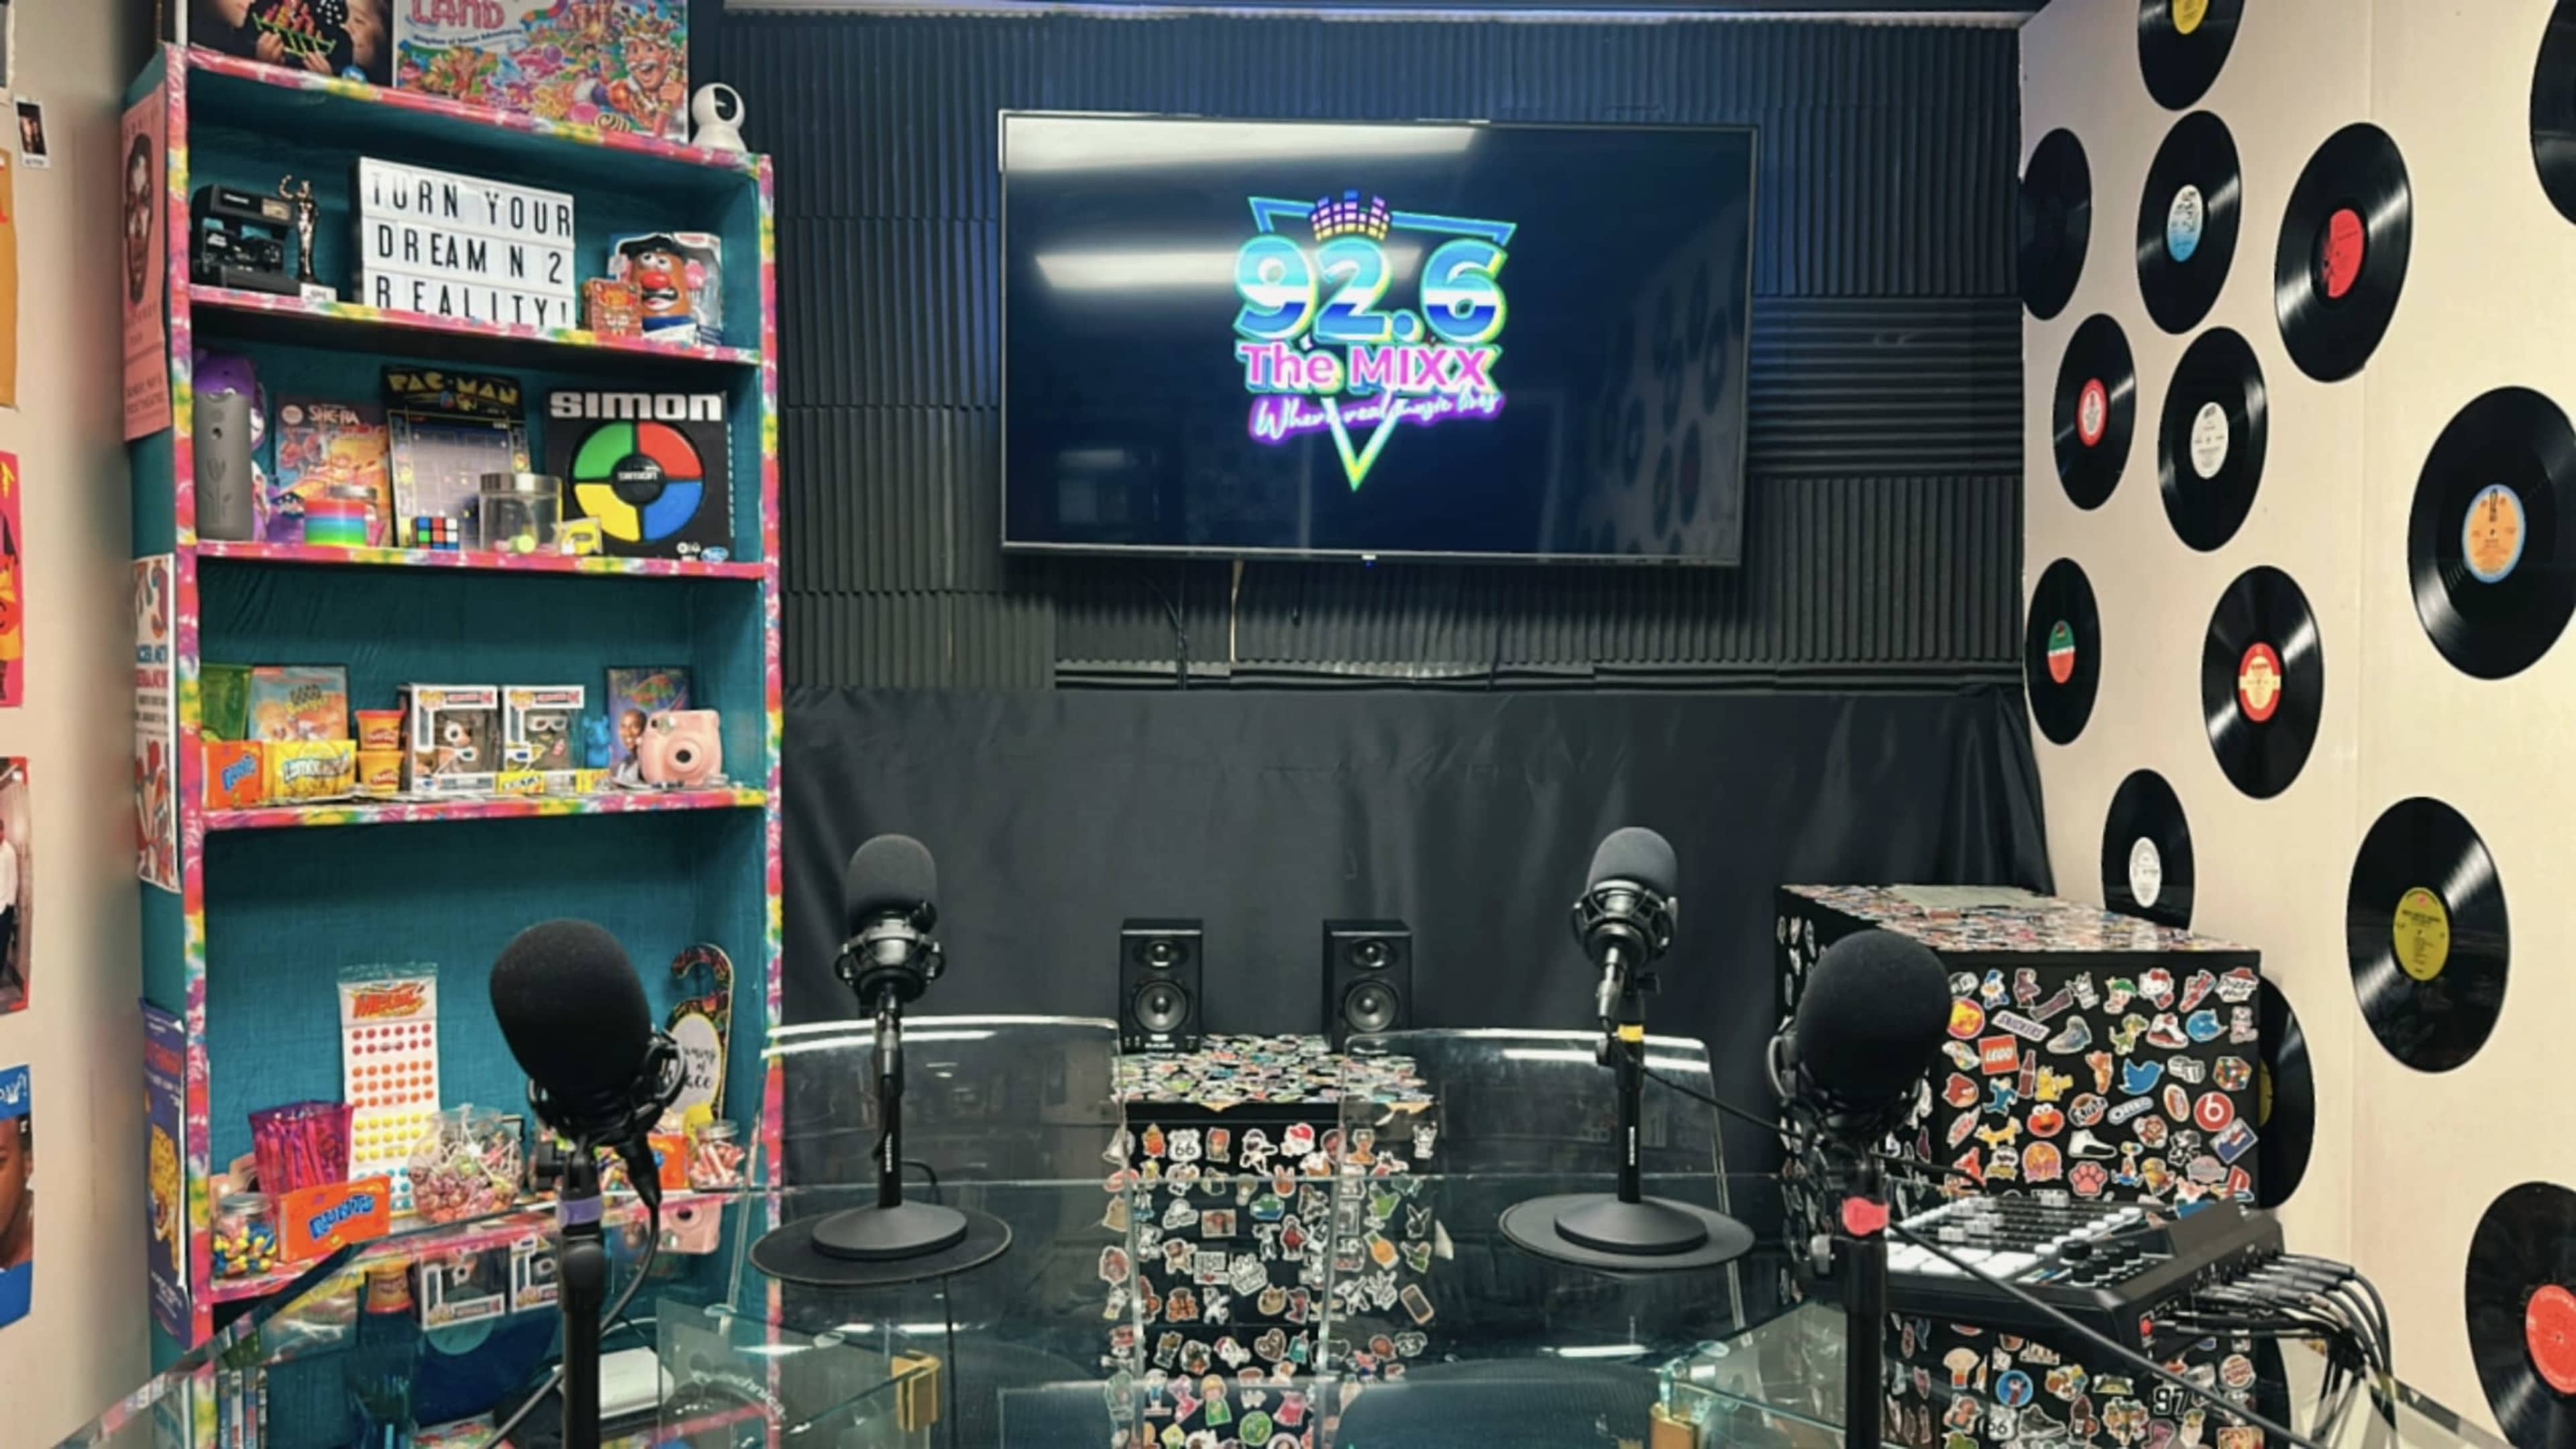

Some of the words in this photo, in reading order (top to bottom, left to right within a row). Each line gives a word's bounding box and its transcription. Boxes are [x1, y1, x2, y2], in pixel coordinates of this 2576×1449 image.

[372, 172, 459, 219] TURN
[484, 190, 571, 237] YOUR
[378, 223, 487, 274] DREAM
[510, 244, 524, 278] N
[547, 251, 563, 284] 2
[375, 274, 568, 327] REALITY!
[1233, 233, 1509, 345] 92.6
[388, 371, 519, 405] PAC-MAN
[1238, 340, 1341, 389] The
[1347, 344, 1497, 390] MIXX
[1175, 1141, 1197, 1157] 66
